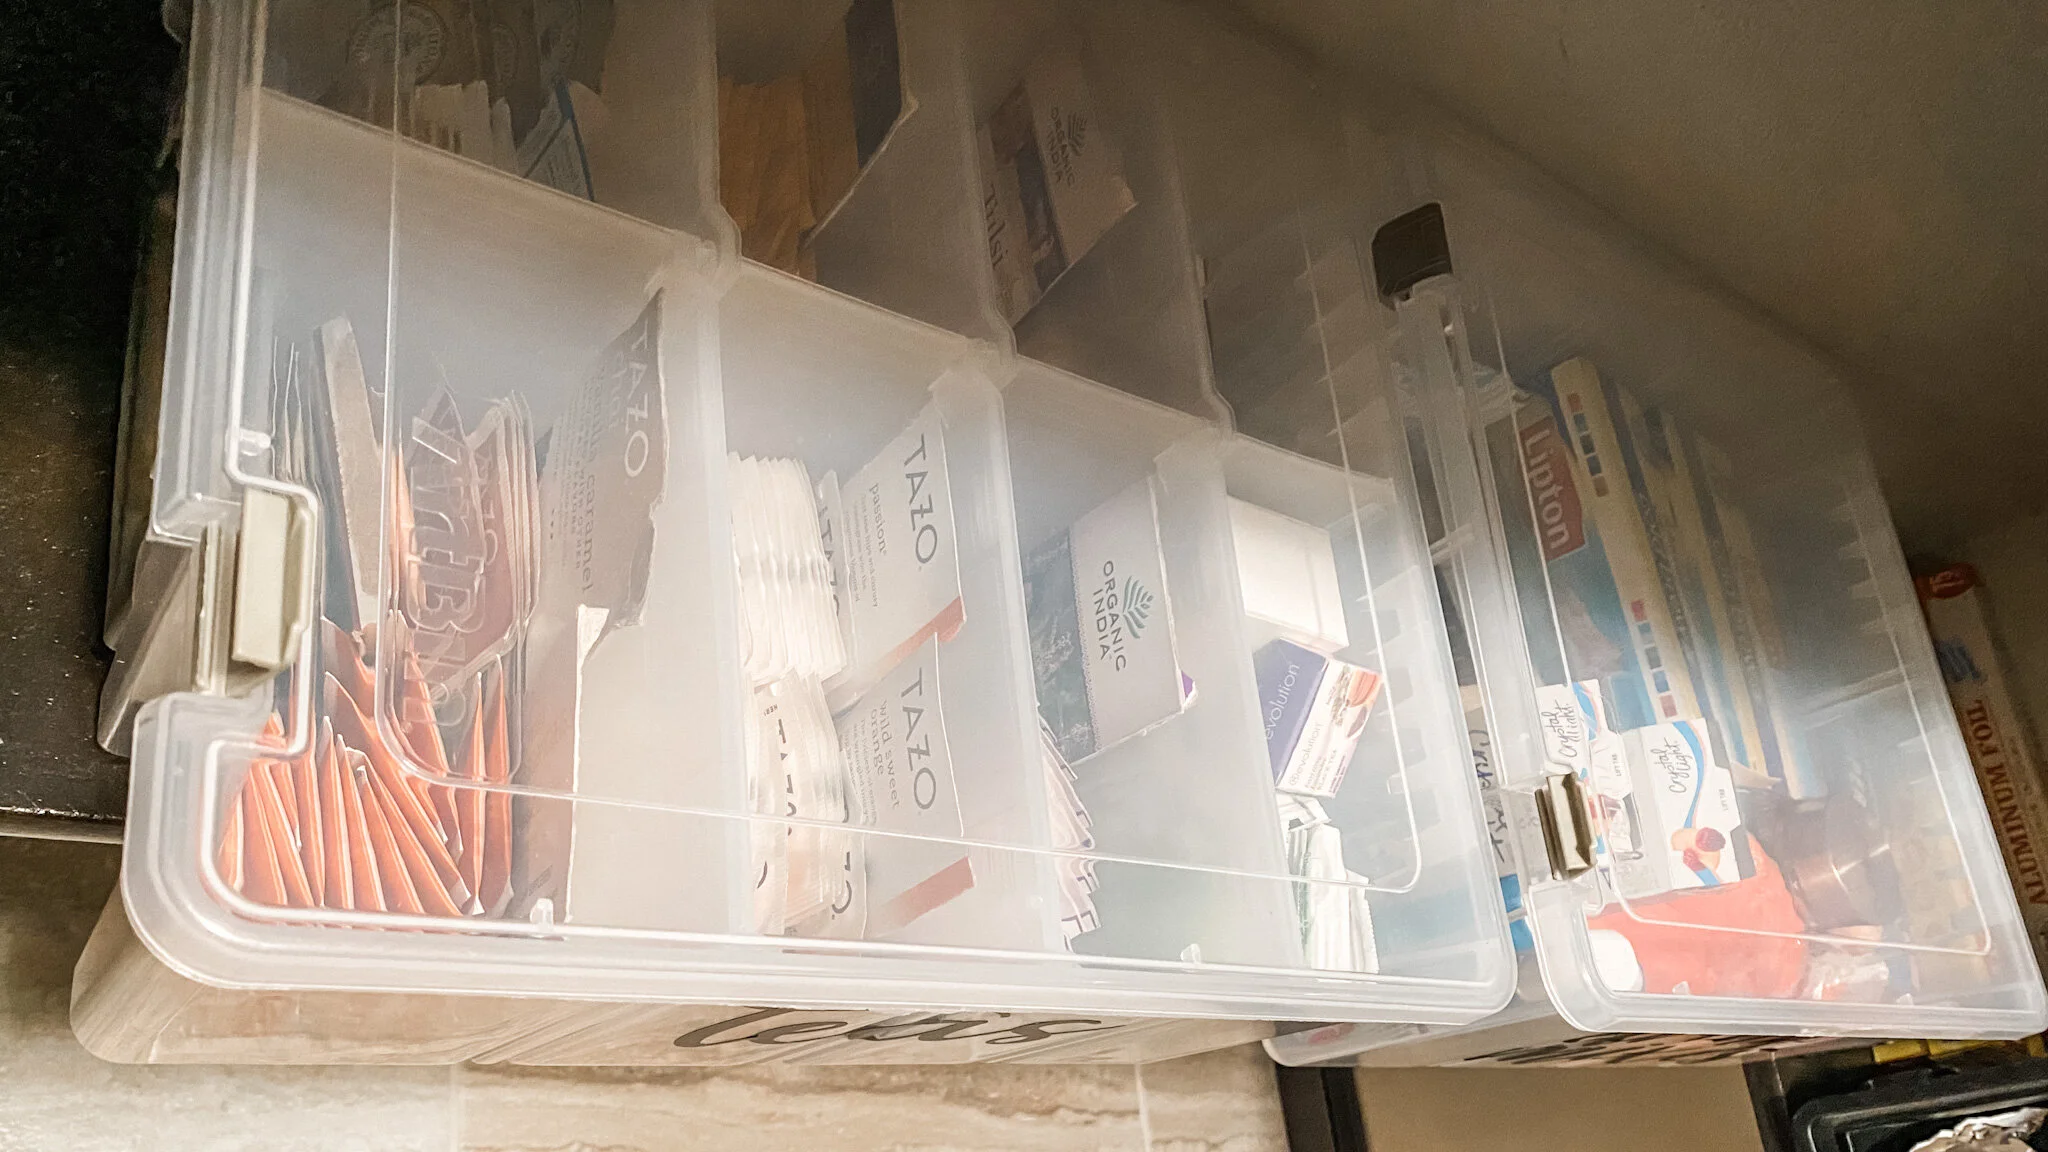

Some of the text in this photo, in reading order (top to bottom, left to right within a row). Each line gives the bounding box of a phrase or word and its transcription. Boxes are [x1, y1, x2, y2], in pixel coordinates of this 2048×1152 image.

[624, 320, 649, 478] TAZO
[581, 475, 596, 592] caramel
[869, 482, 888, 553] passion
[904, 433, 937, 564] TAZO
[1525, 429, 1571, 549] Lipton
[1093, 589, 1110, 660] INDIA
[1103, 561, 1126, 672] ORGANIC
[871, 708, 884, 776] orange
[879, 700, 900, 808] wild sweet
[902, 667, 937, 810] TAZO
[1650, 746, 1687, 795] Crystal
[1966, 700, 1998, 757] FOIL
[1985, 764, 2048, 904] ALUMINUM
